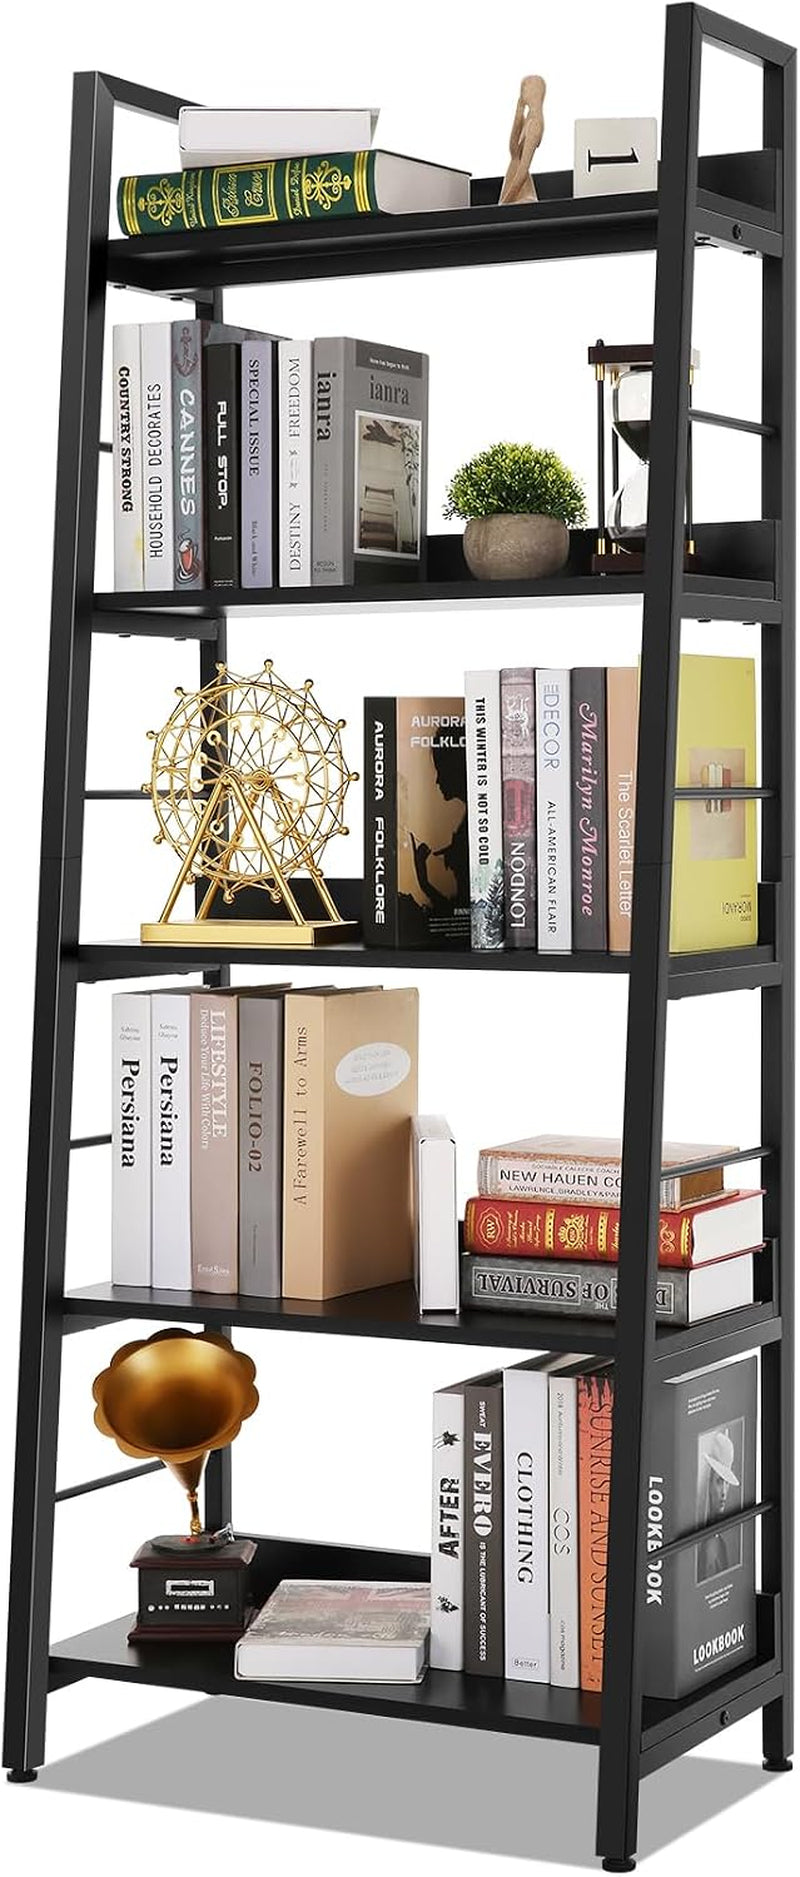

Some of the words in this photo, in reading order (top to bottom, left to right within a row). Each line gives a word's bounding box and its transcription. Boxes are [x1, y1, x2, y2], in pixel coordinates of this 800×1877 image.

[587, 147, 639, 172] 1
[118, 366, 131, 445] COUNTRY
[249, 359, 260, 430] SPECIAL
[289, 357, 300, 438] FREEDOM
[316, 372, 337, 441] ianra
[369, 375, 410, 405] ianra
[147, 383, 162, 466] DECORATES
[216, 400, 228, 447] FULL
[180, 388, 196, 516] CANNES
[249, 431, 260, 476] ISSUE
[120, 447, 134, 513] STRONG
[217, 454, 228, 510] STOP.
[148, 477, 163, 558] HOUSEHOLD
[289, 502, 301, 572] DESTINY
[475, 697, 486, 724] THIS
[374, 720, 384, 801] AURORA
[477, 774, 488, 786] IS
[577, 702, 598, 811] Marilyn
[477, 793, 488, 816] NOT
[617, 770, 633, 804] The
[478, 818, 489, 833] SO
[547, 800, 557, 896] ALL-AMERICAN
[617, 807, 633, 866] Scarlet
[374, 816, 385, 925] FOLKLORE
[479, 836, 490, 866] COLD
[579, 817, 598, 917] Monroe
[510, 842, 525, 928] LONDON
[617, 867, 633, 918] Letter
[548, 899, 557, 933] FLAIR
[200, 1009, 208, 1045] Deduce
[294, 1026, 308, 1068] Arms
[200, 1046, 208, 1070] Your
[201, 1072, 209, 1090] Life
[210, 1011, 227, 1138] LIFESTYLE
[159, 1056, 178, 1167] Persiana
[201, 1092, 209, 1117] With
[296, 1078, 308, 1097] to
[120, 1059, 141, 1168] Persiana
[248, 1060, 263, 1173] FOLIO-02
[292, 1109, 308, 1192] Farewell
[293, 1194, 307, 1206] A
[500, 1169, 537, 1183] NEW
[542, 1170, 598, 1187] HAUEN
[477, 1273, 577, 1299] SURVIVAL
[582, 1285, 609, 1301] OF
[478, 1400, 487, 1428] SWEAT
[590, 1403, 614, 1505] SUNRISE
[438, 1477, 460, 1559] AFTER
[516, 1451, 534, 1585] CLOTHING
[552, 1507, 571, 1556] COS
[590, 1510, 610, 1567] AND
[479, 1541, 487, 1549] IS
[479, 1551, 487, 1565] THE
[478, 1567, 487, 1611] LUBRICANT
[478, 1613, 487, 1623] OF
[478, 1624, 487, 1662] SUCCESS
[692, 1623, 745, 1666] LOOKBOOK
